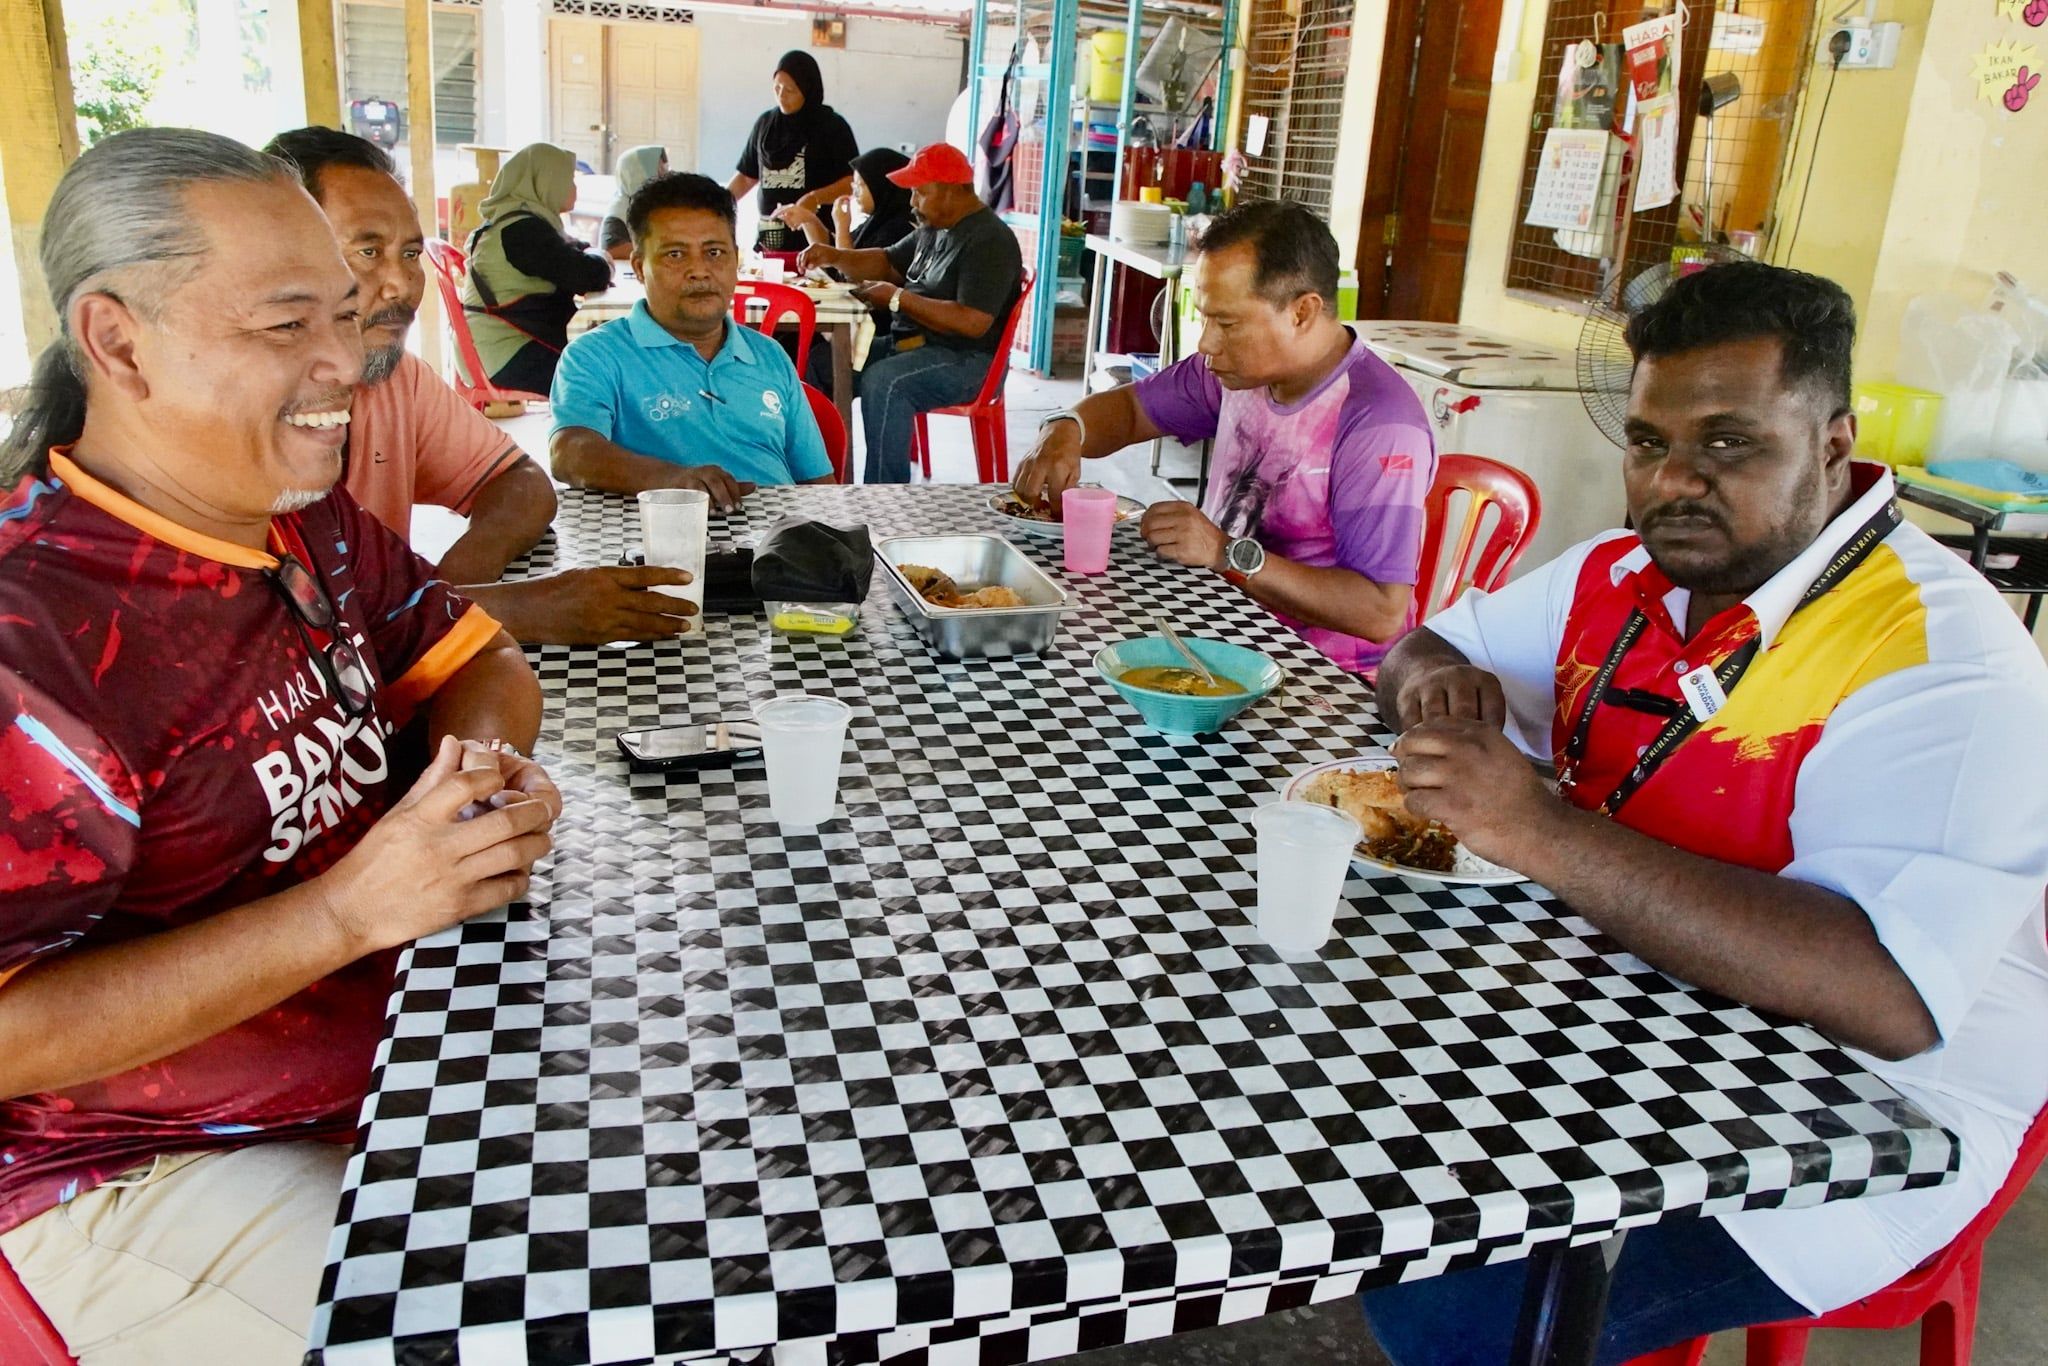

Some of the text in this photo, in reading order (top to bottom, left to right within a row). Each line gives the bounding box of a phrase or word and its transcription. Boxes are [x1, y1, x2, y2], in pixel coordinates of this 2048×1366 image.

[1989, 55, 2014, 66] IKAN
[1984, 68, 2018, 84] BAKAR
[1825, 545, 1861, 578] PILIHAN
[1857, 528, 1878, 549] RAYA
[1581, 700, 1597, 723] RAYA
[1697, 685, 1716, 715] MADANI
[1641, 713, 1691, 767] SURUHANJAYA
